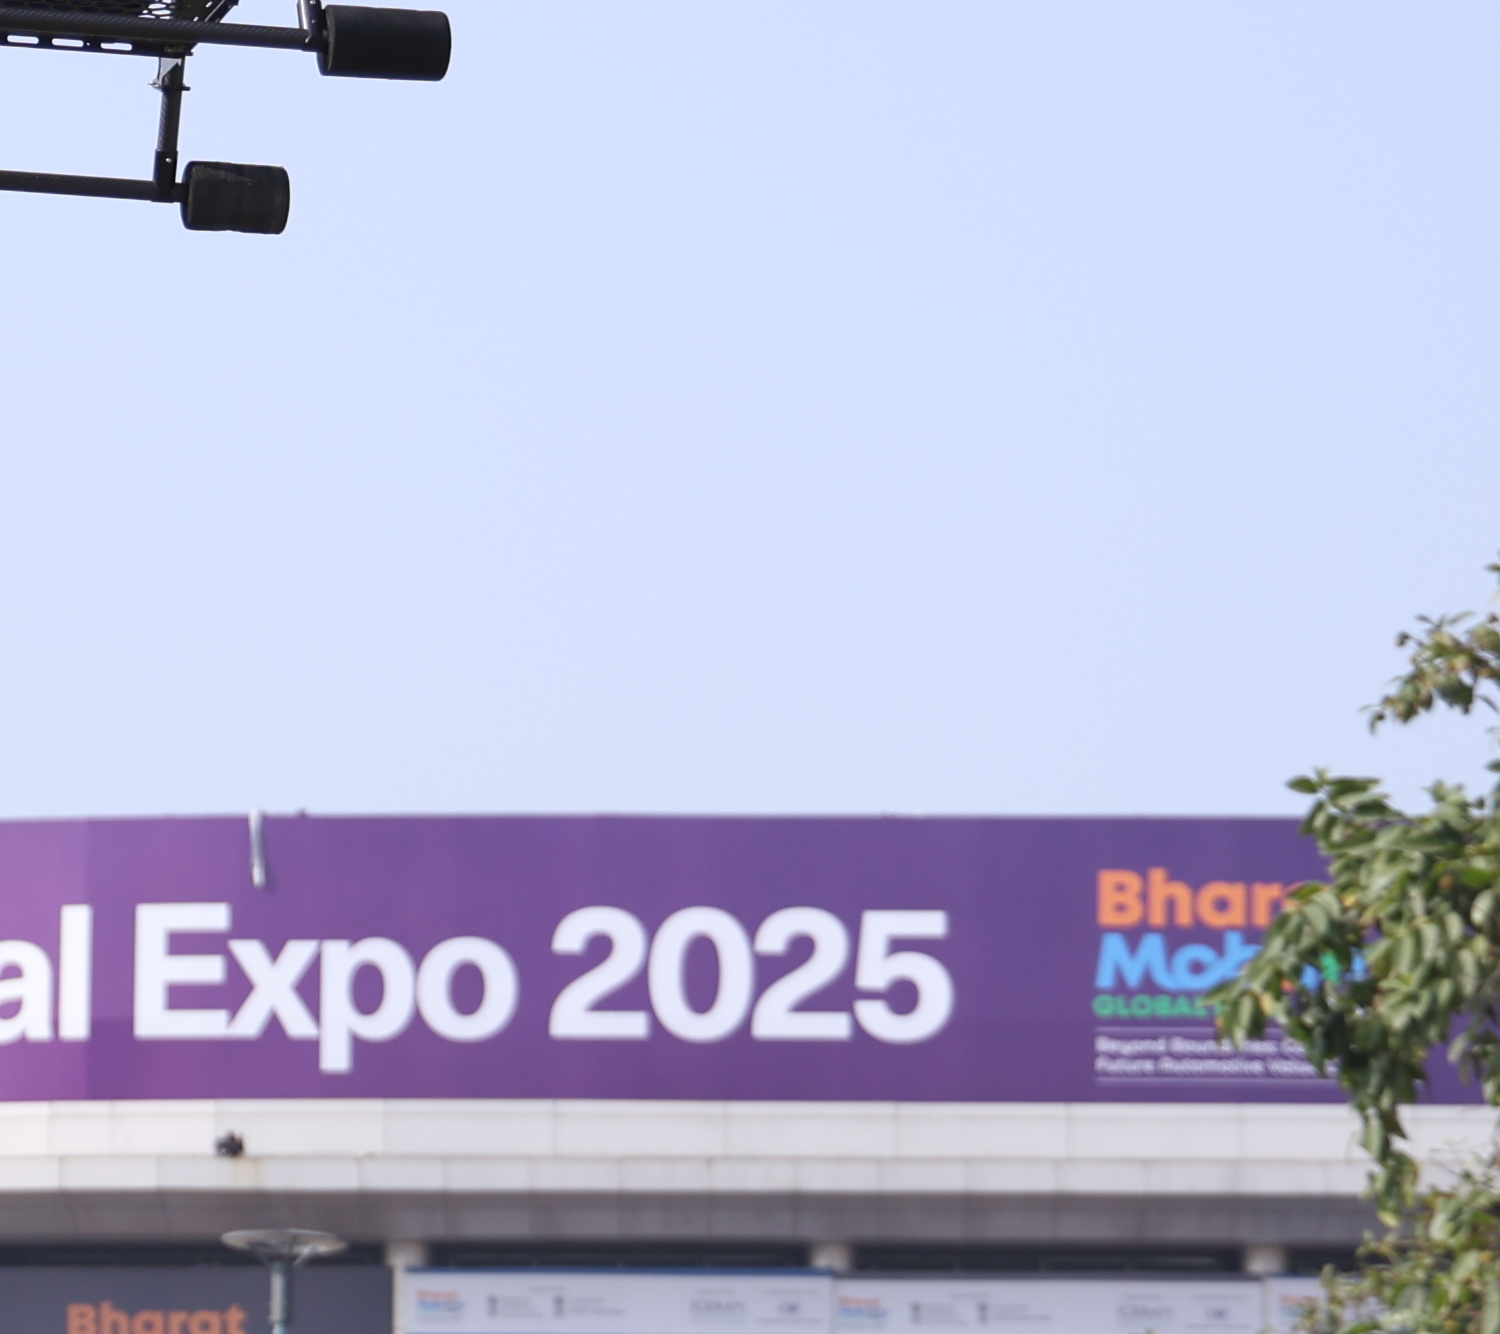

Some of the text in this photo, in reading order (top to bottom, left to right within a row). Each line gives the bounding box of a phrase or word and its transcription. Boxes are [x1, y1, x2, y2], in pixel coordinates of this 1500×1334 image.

[1096, 867, 1302, 929] Bhar
[133, 901, 521, 1074] Expo
[548, 905, 956, 1045] 2025
